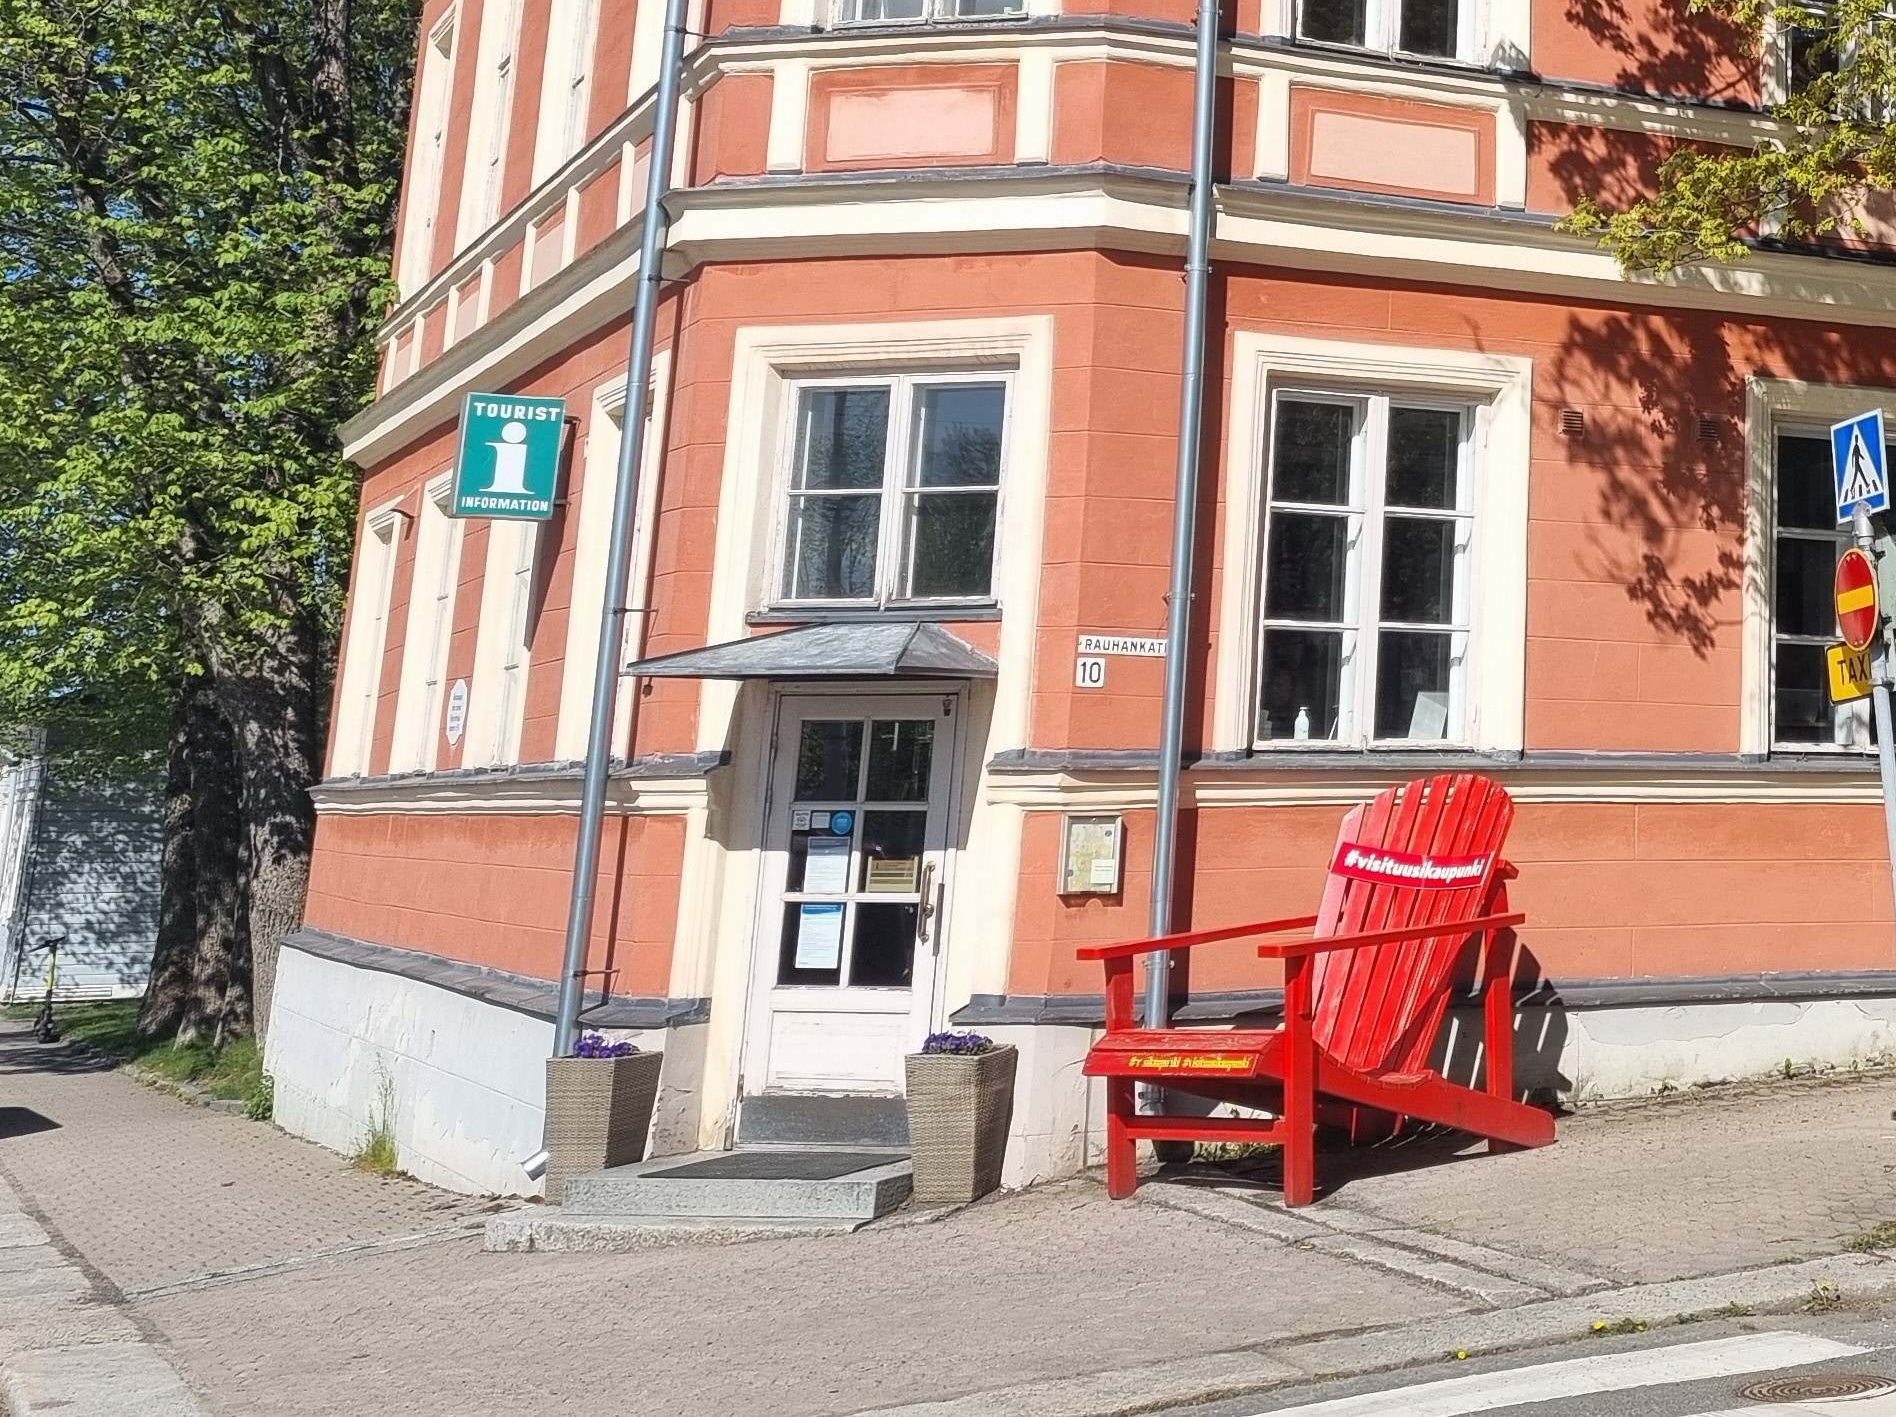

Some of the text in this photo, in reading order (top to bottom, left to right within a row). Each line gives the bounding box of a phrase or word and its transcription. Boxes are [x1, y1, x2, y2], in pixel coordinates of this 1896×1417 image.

[473, 402, 561, 422] TOURIST
[461, 496, 549, 512] INFORMATION
[1080, 661, 1102, 684] 10
[1837, 653, 1872, 687] TAXI
[1343, 848, 1485, 884] #visituusikaupunki
